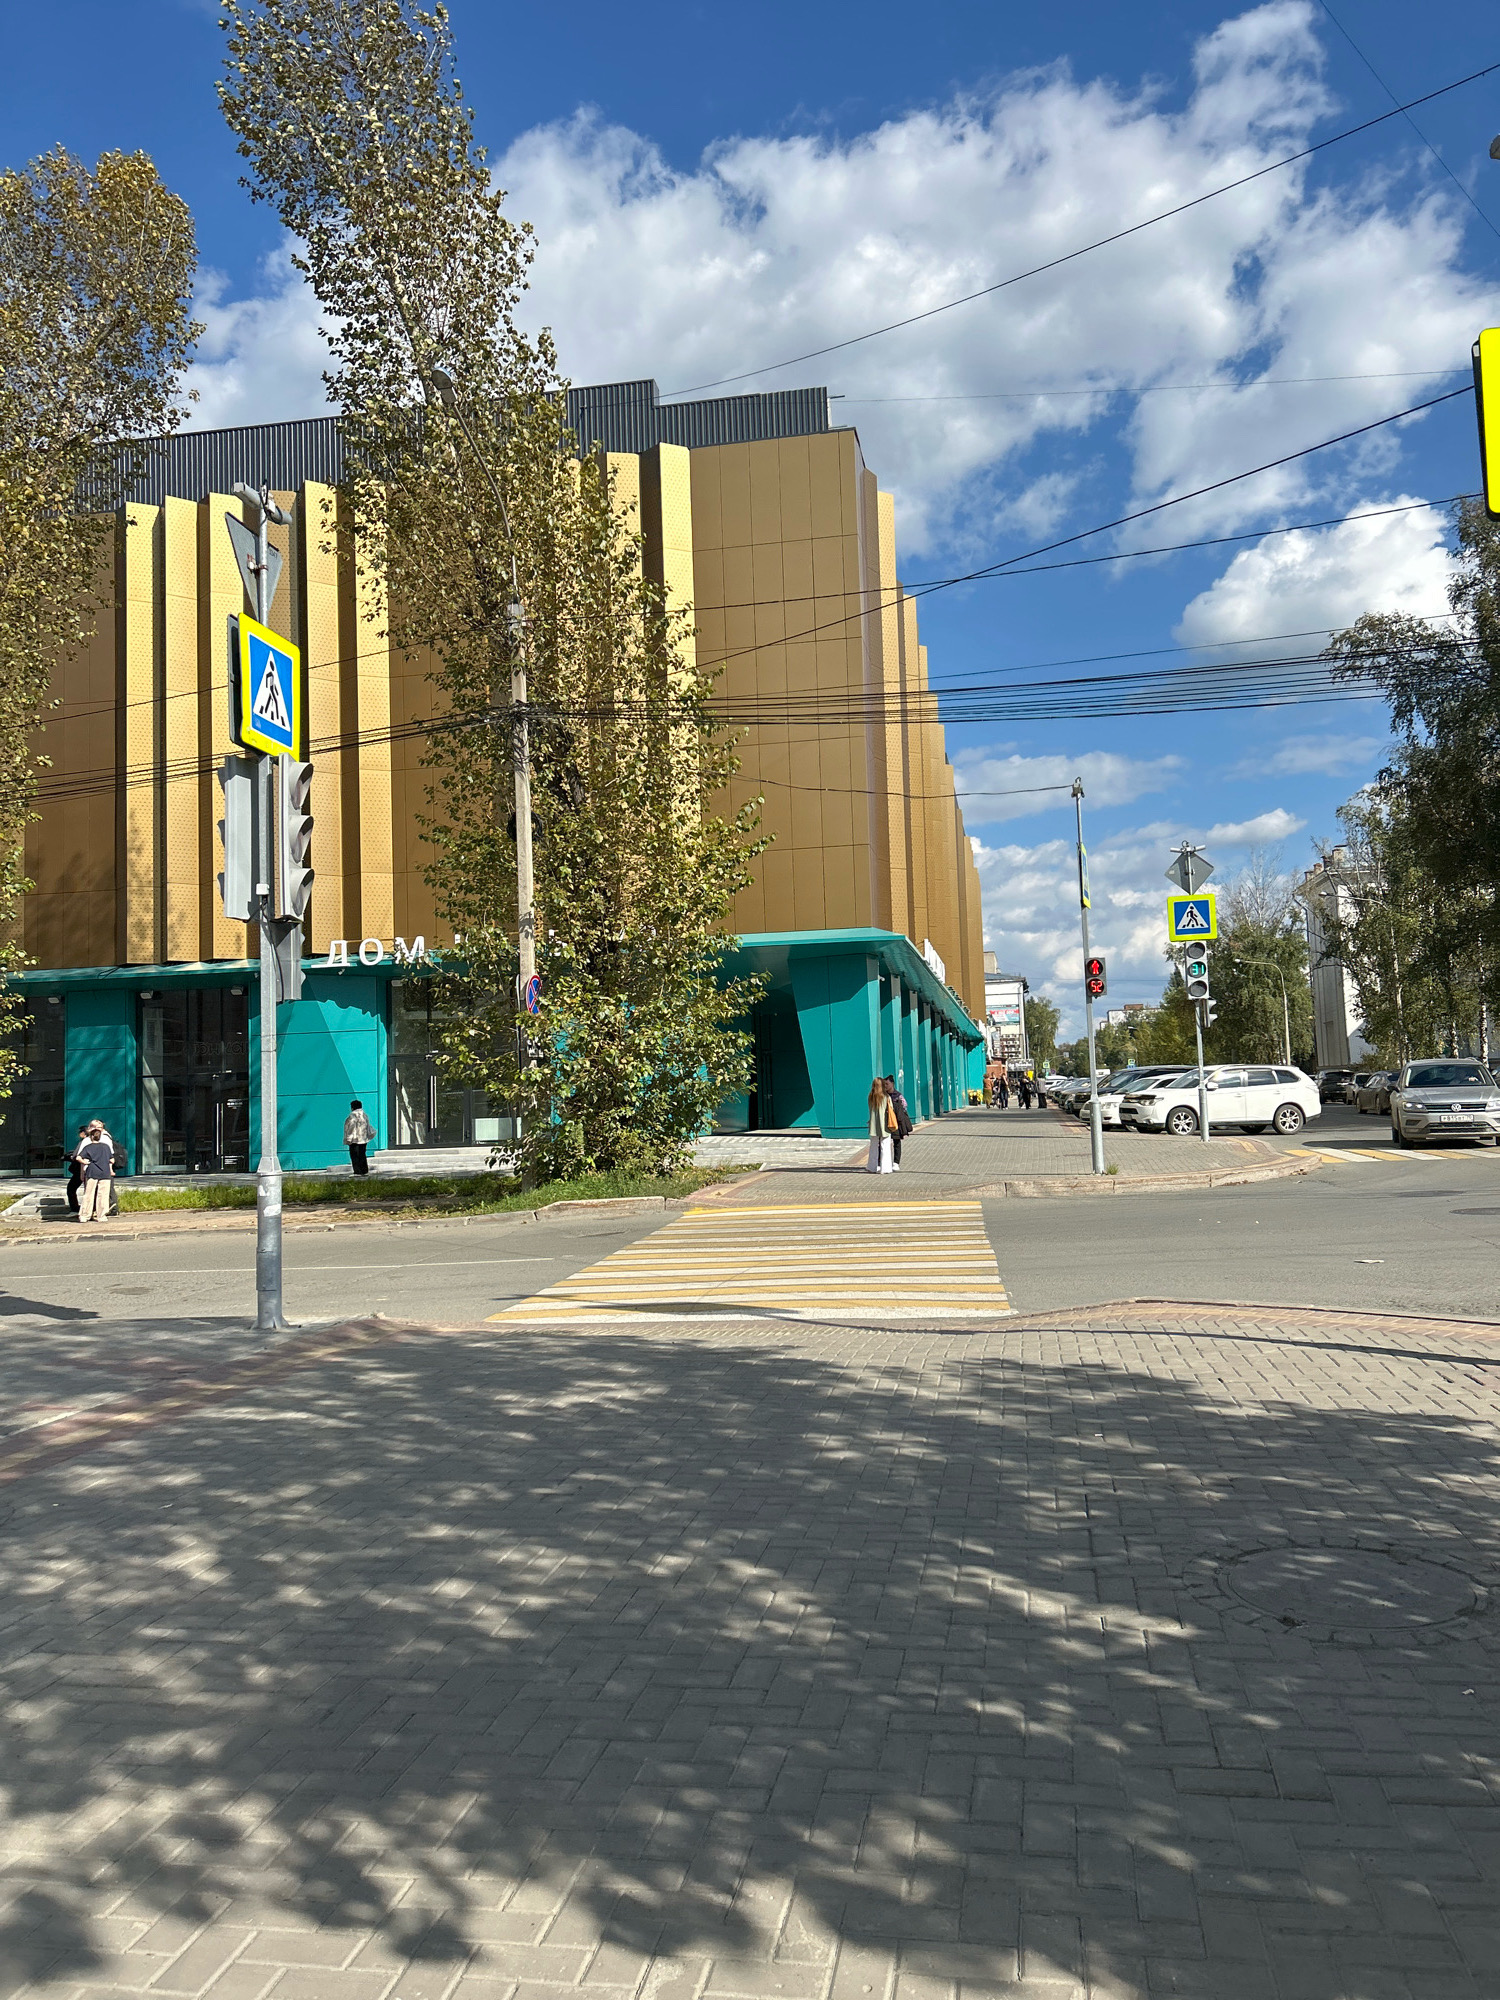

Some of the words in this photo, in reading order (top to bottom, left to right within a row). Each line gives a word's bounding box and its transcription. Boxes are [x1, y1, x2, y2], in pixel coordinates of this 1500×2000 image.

[311, 935, 425, 968] ДОМ
[1192, 964, 1205, 975] 31
[1091, 980, 1103, 993] 52
